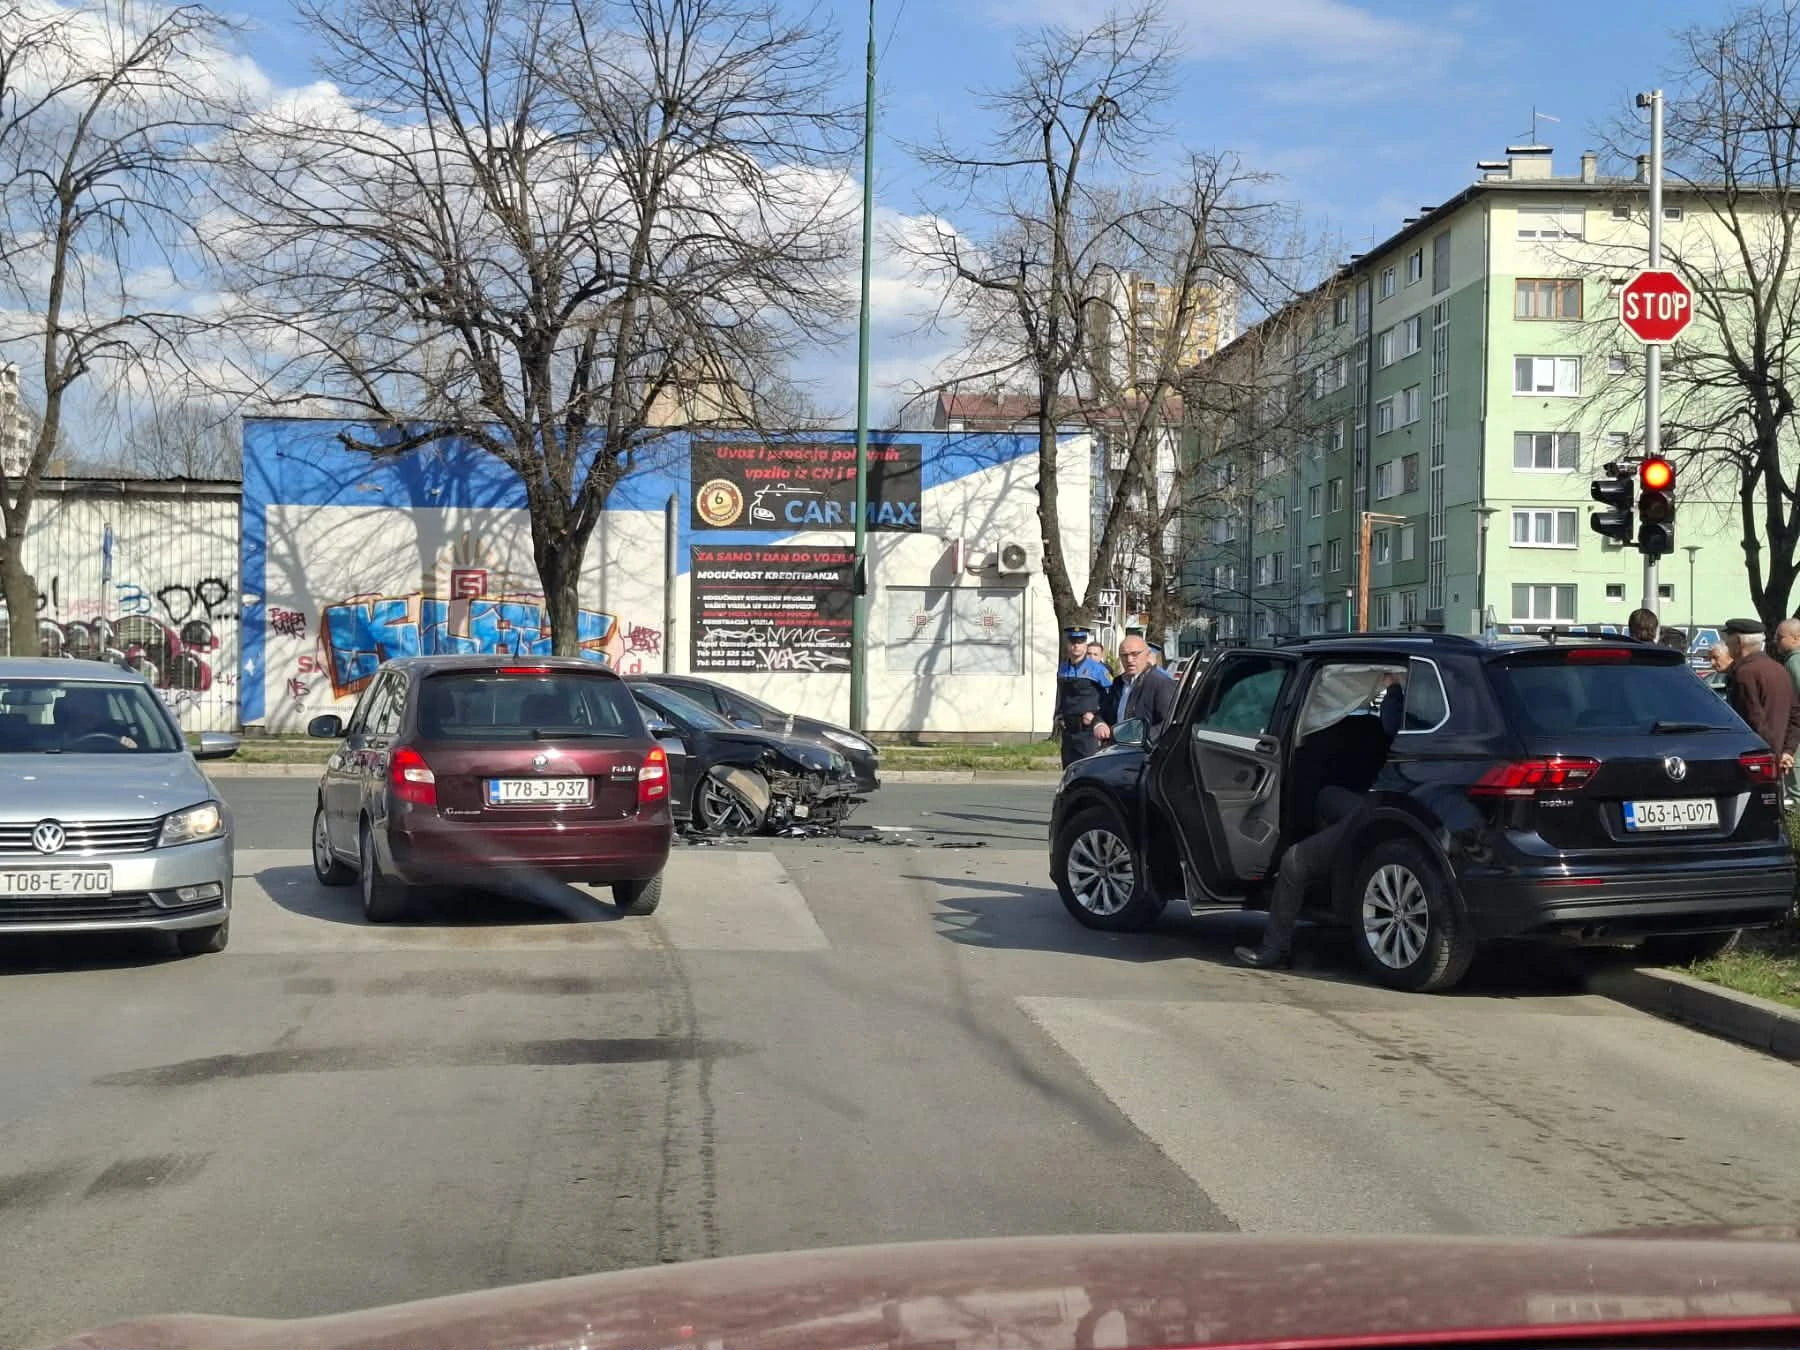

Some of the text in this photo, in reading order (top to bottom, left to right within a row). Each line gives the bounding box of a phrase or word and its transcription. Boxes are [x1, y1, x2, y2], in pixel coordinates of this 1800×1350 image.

[1626, 291, 1688, 321] STOP
[716, 447, 752, 460] Uvoz
[714, 492, 724, 505] 6
[784, 500, 917, 525] CAR MAX
[697, 552, 714, 562] ZA
[716, 552, 753, 562] SAMO
[762, 552, 790, 562] DAN
[791, 553, 811, 563] DO
[697, 569, 763, 580] MOGUĆNOST
[502, 780, 586, 798] T78-J-937
[1637, 800, 1714, 825] J63-A-097
[3, 871, 109, 893] T08-E-700
